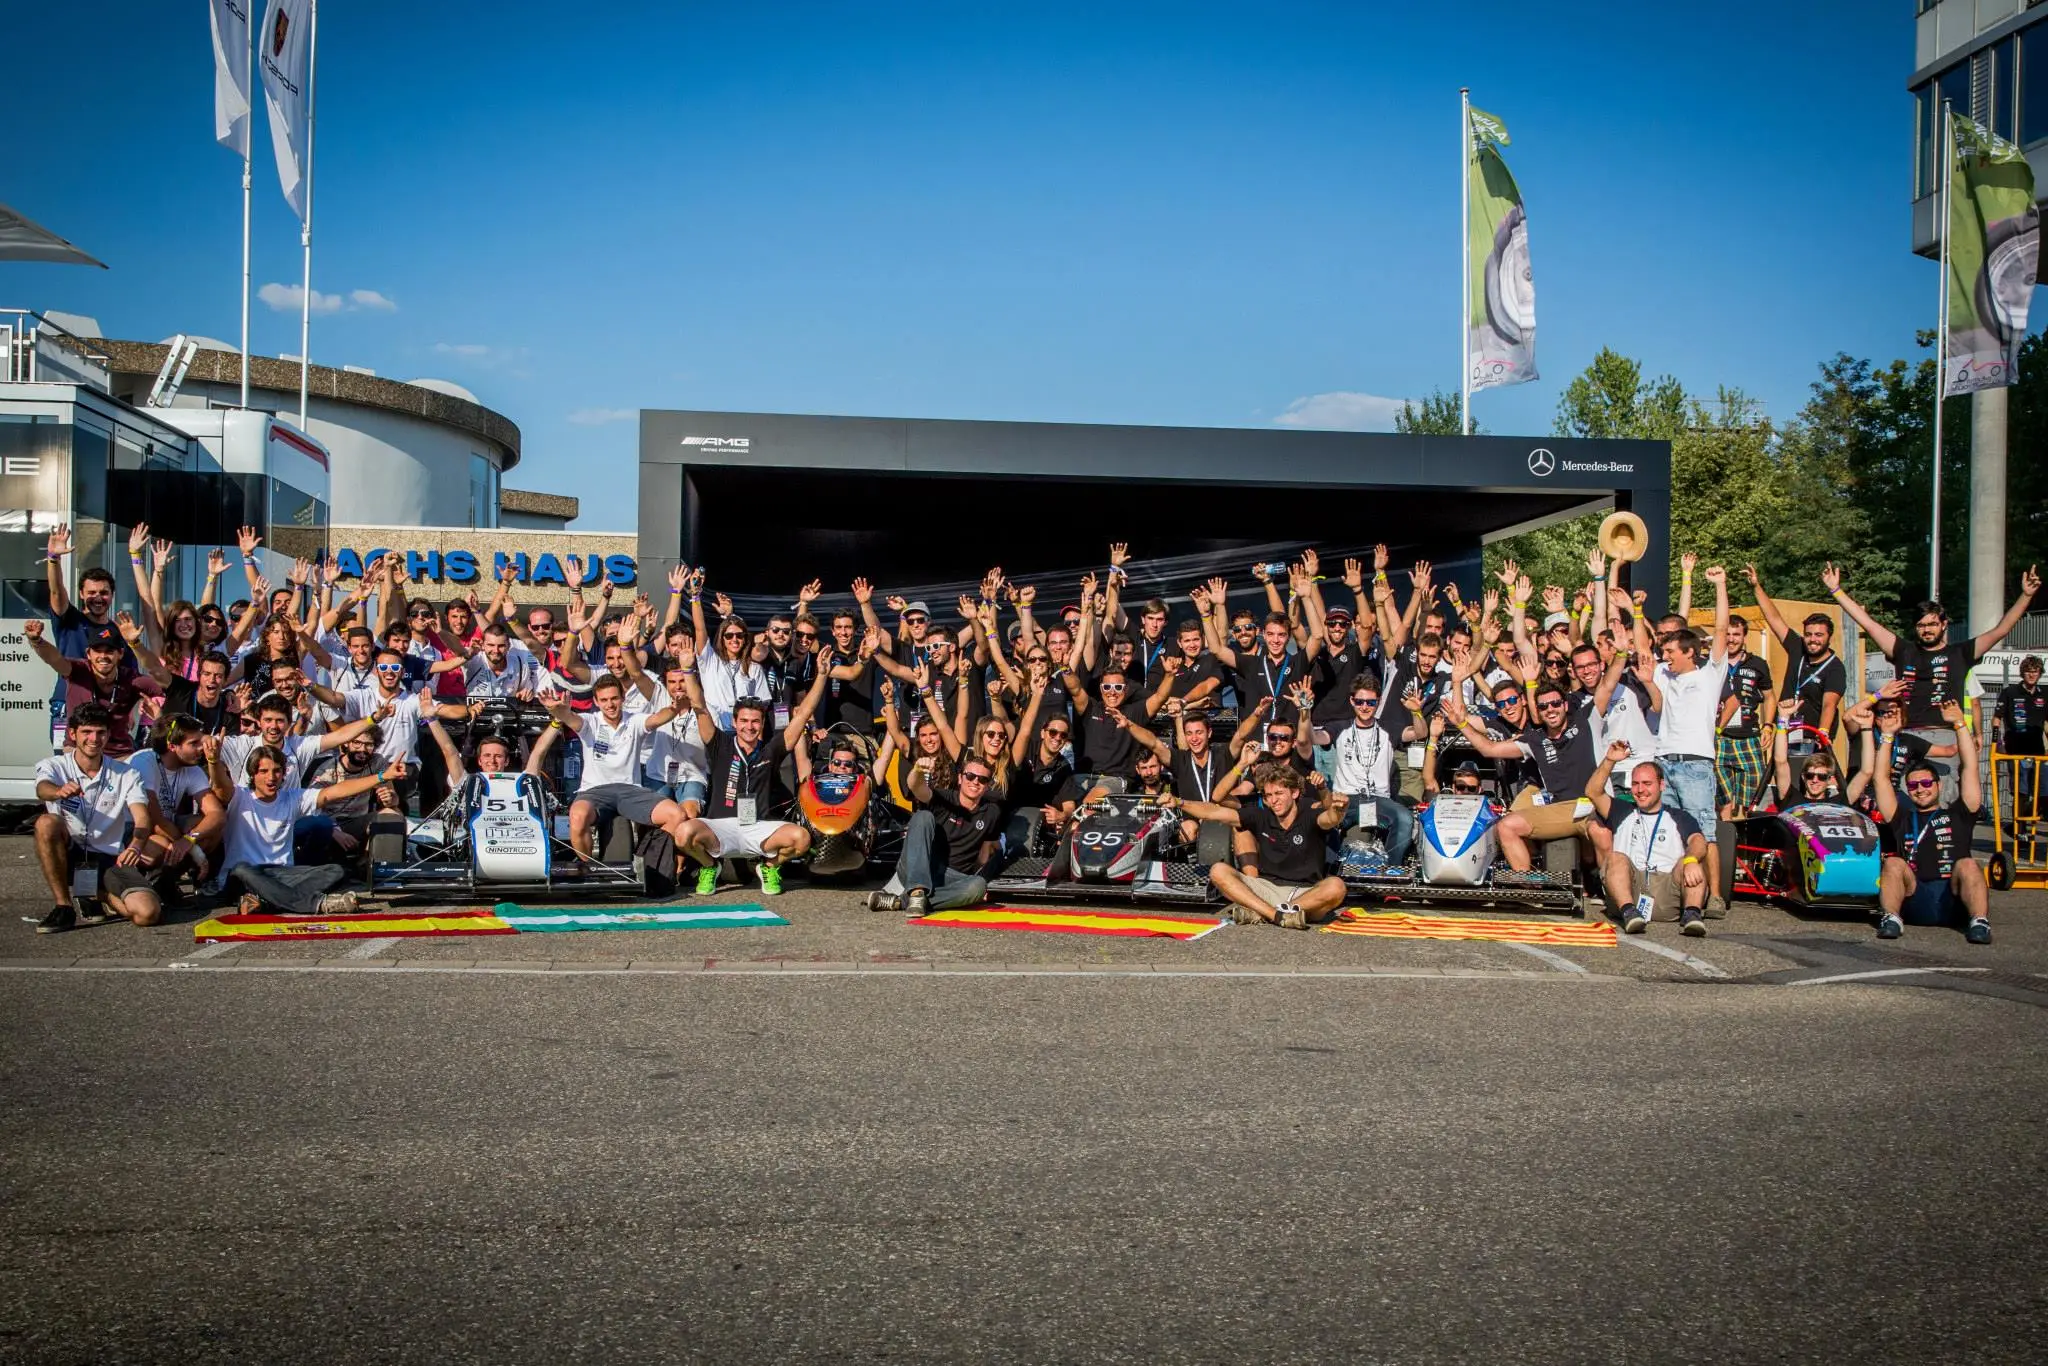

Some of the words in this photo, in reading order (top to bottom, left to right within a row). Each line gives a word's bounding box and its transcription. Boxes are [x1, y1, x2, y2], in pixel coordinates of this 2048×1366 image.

[701, 437, 749, 447] AMG
[0, 457, 40, 475] E
[1562, 461, 1634, 472] Mercedes-Benz
[494, 551, 636, 585] HAUS
[1, 698, 42, 711] ipment
[486, 799, 525, 812] 51
[1081, 831, 1124, 846] 95
[1827, 827, 1856, 837] 46
